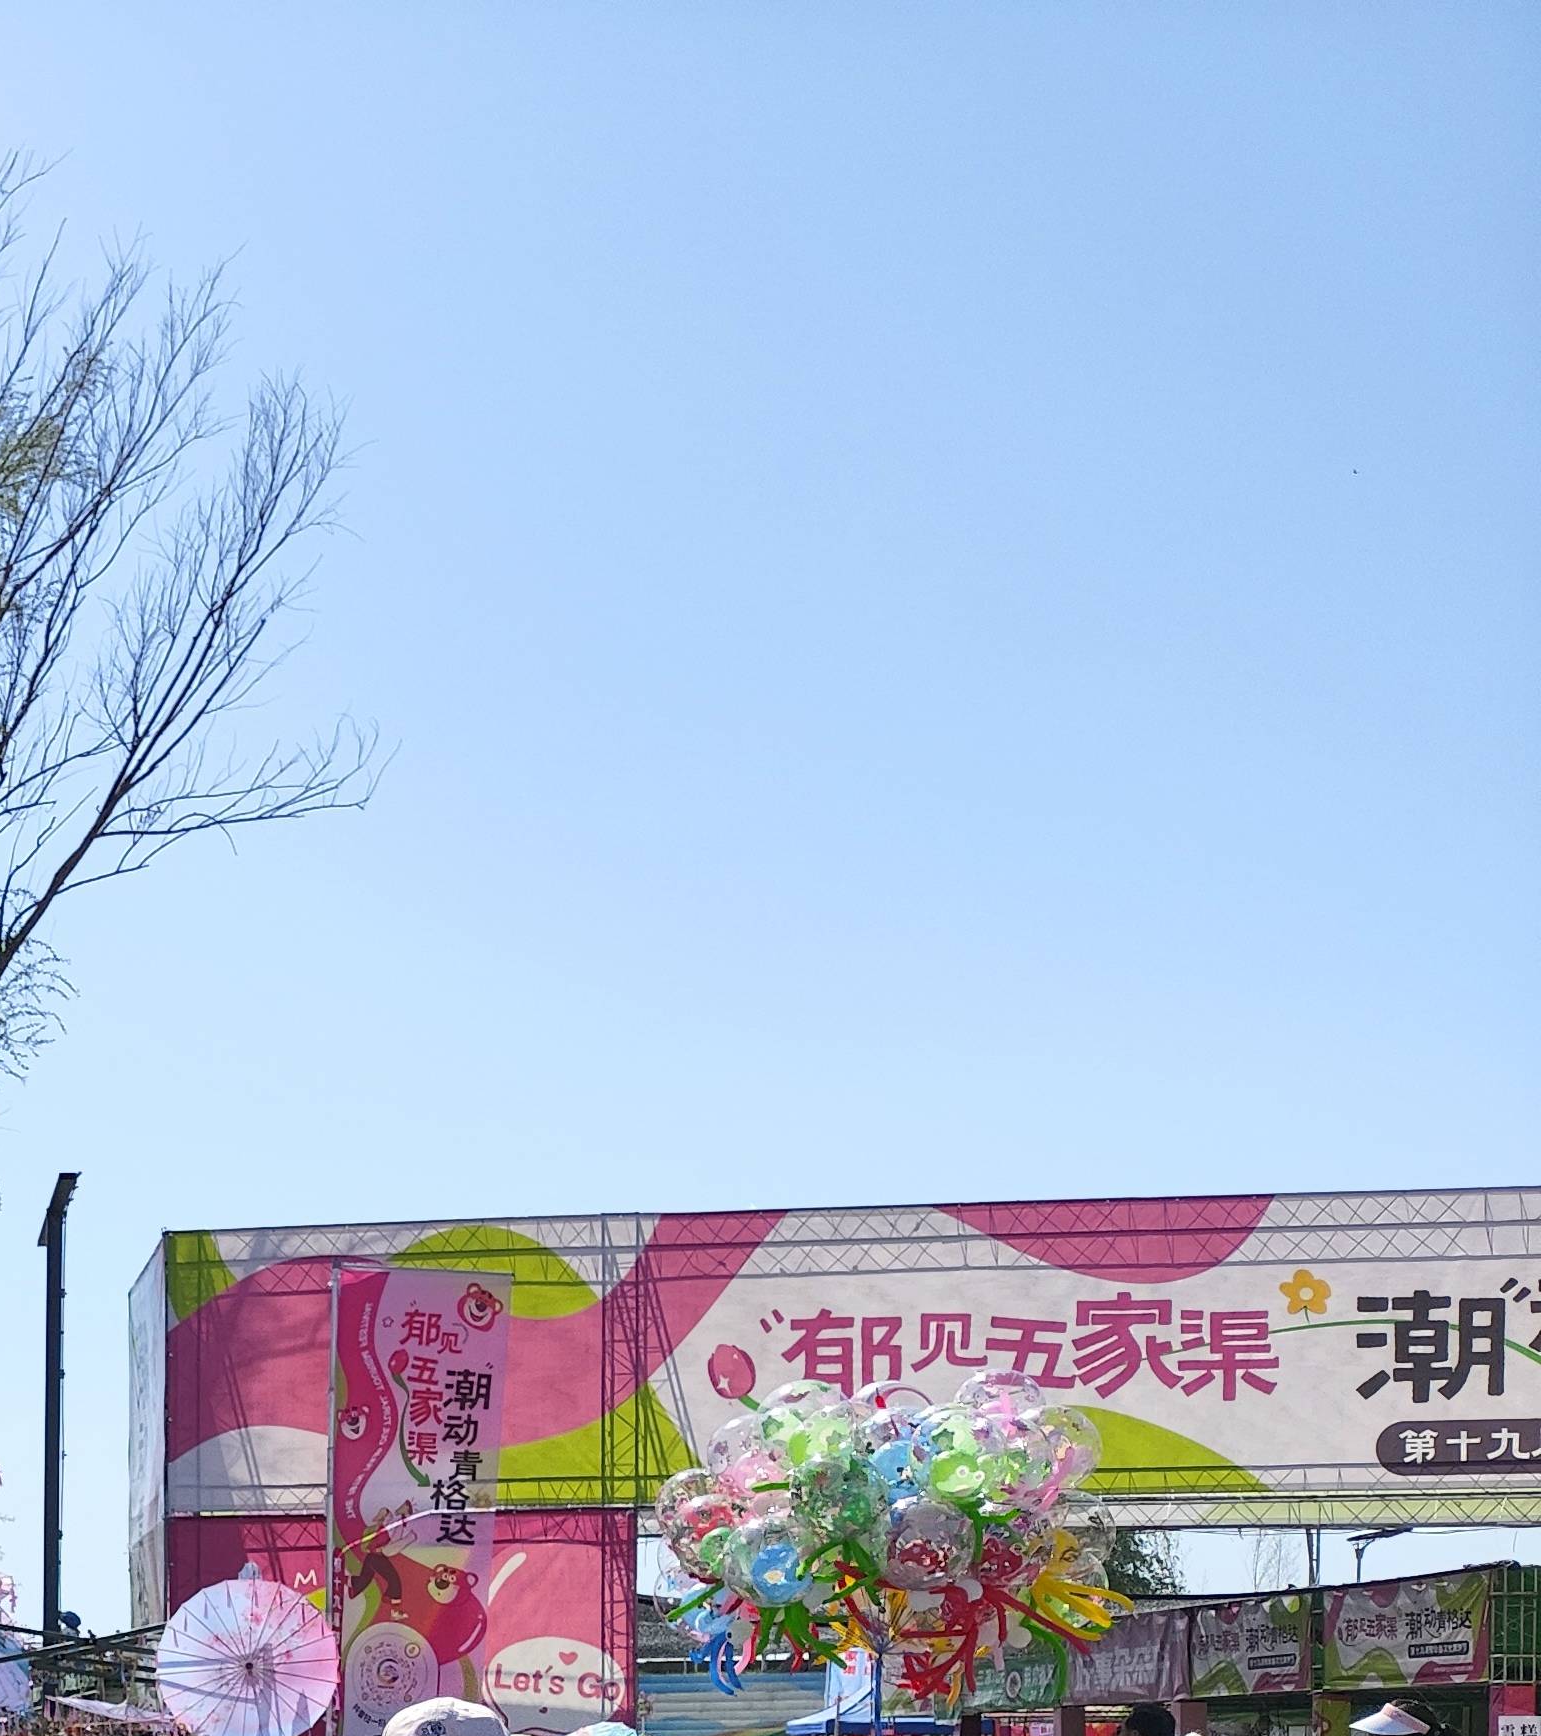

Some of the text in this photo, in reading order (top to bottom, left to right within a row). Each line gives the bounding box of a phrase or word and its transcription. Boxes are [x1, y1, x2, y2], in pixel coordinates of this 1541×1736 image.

[1399, 1427, 1541, 1464] 第十九
[494, 1662, 623, 1701] Let's Go
